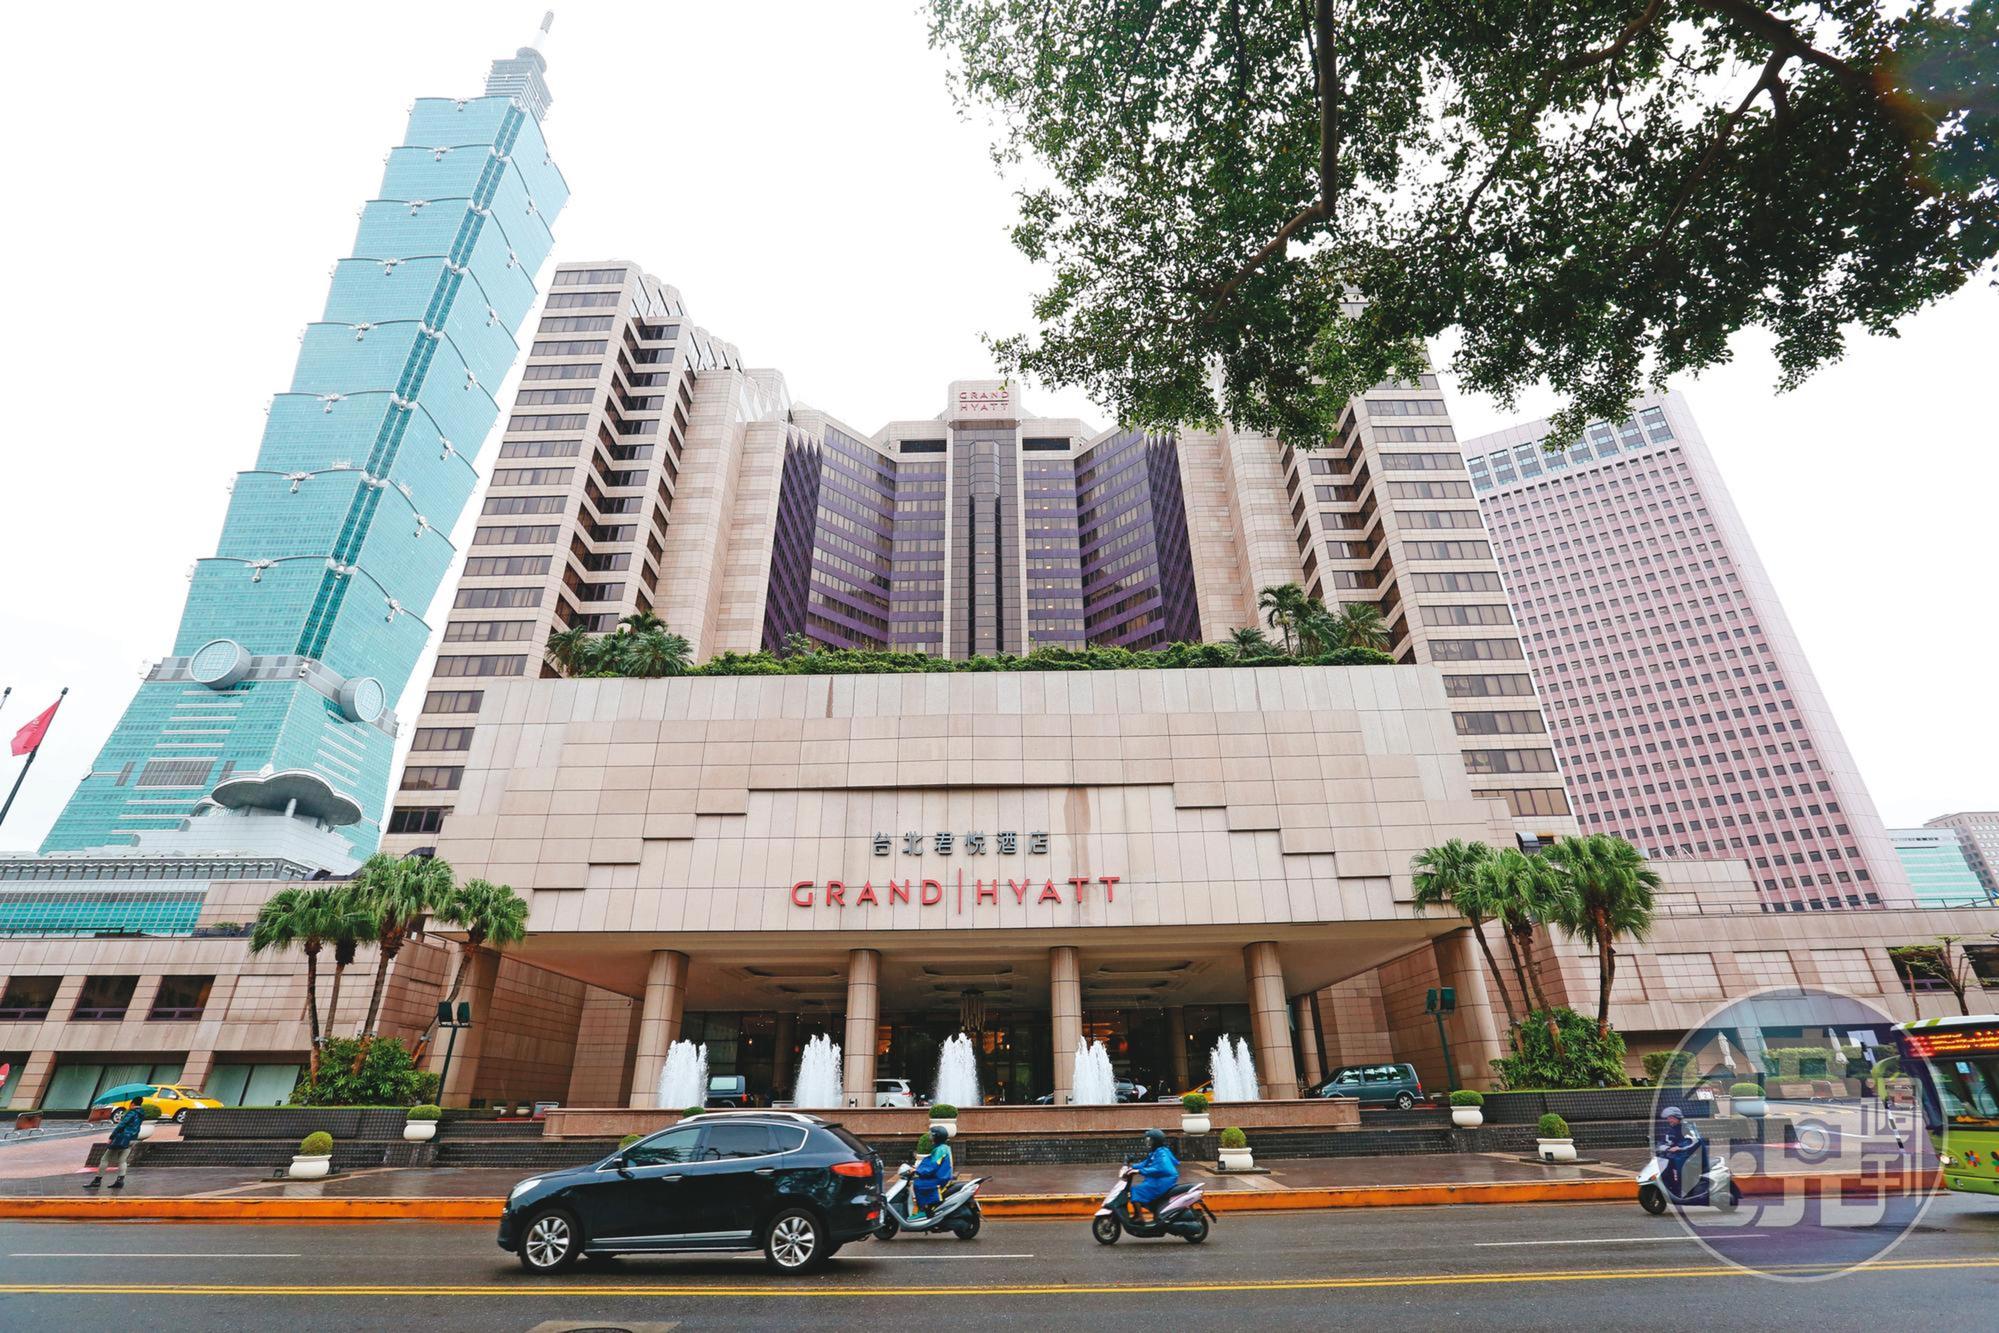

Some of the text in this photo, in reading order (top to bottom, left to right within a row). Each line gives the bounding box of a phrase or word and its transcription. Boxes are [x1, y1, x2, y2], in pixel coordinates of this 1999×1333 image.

[960, 391, 1009, 399] GRAND
[960, 403, 1009, 411] HYATT
[791, 876, 1121, 907] GRAND HYATT
